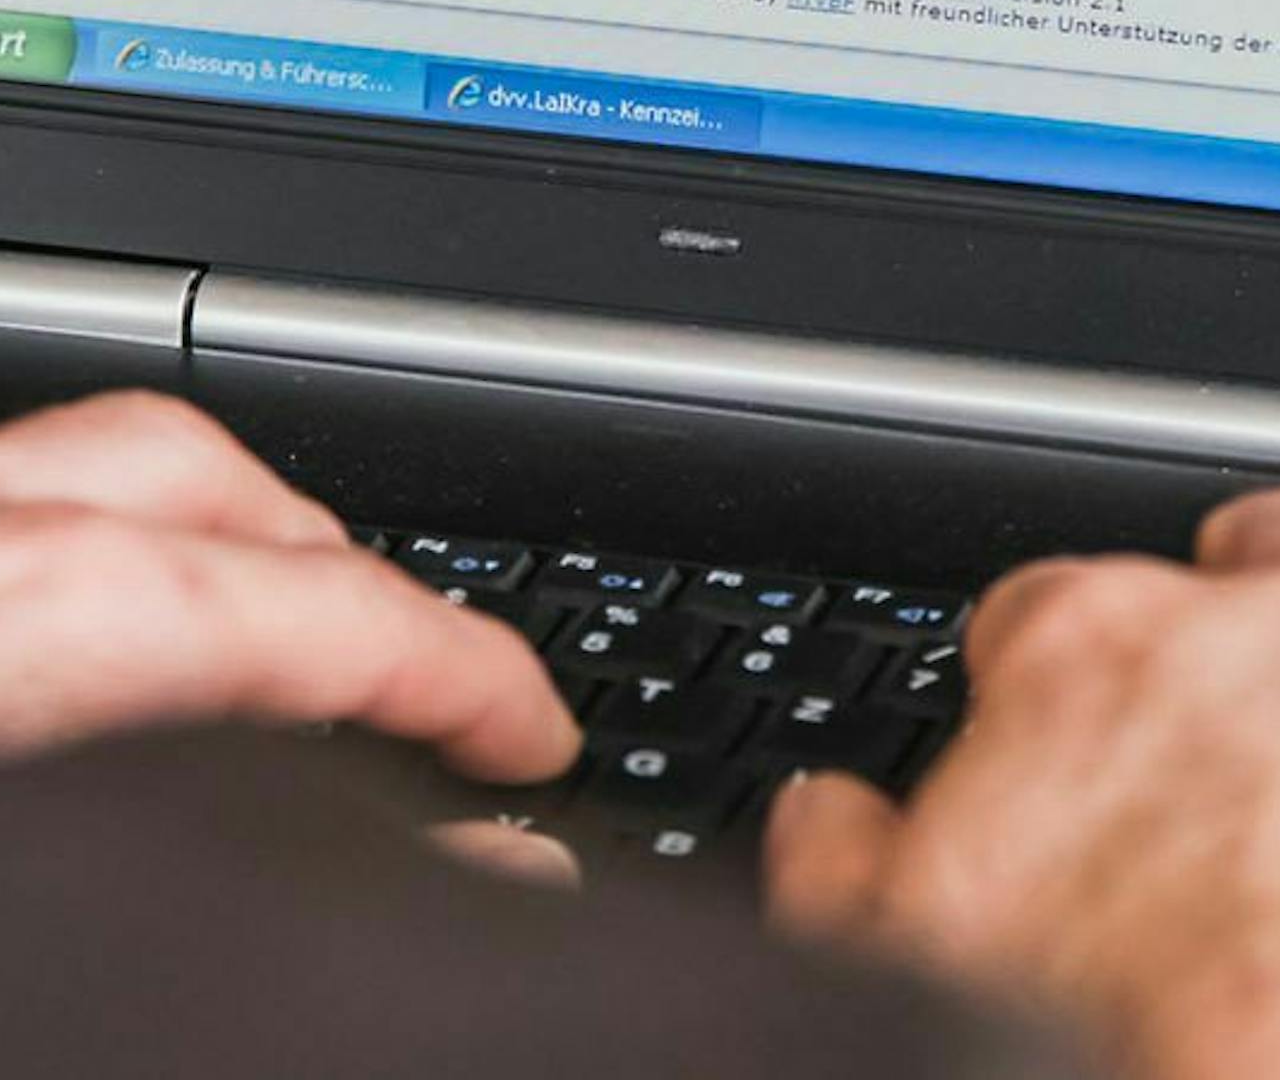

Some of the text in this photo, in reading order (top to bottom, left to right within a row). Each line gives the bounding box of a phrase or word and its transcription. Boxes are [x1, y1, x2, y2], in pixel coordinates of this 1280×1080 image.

[864, 0, 903, 17] mit
[1233, 34, 1273, 56] der
[156, 48, 255, 82] Zulassung
[638, 676, 675, 703] T
[623, 748, 667, 778] G
